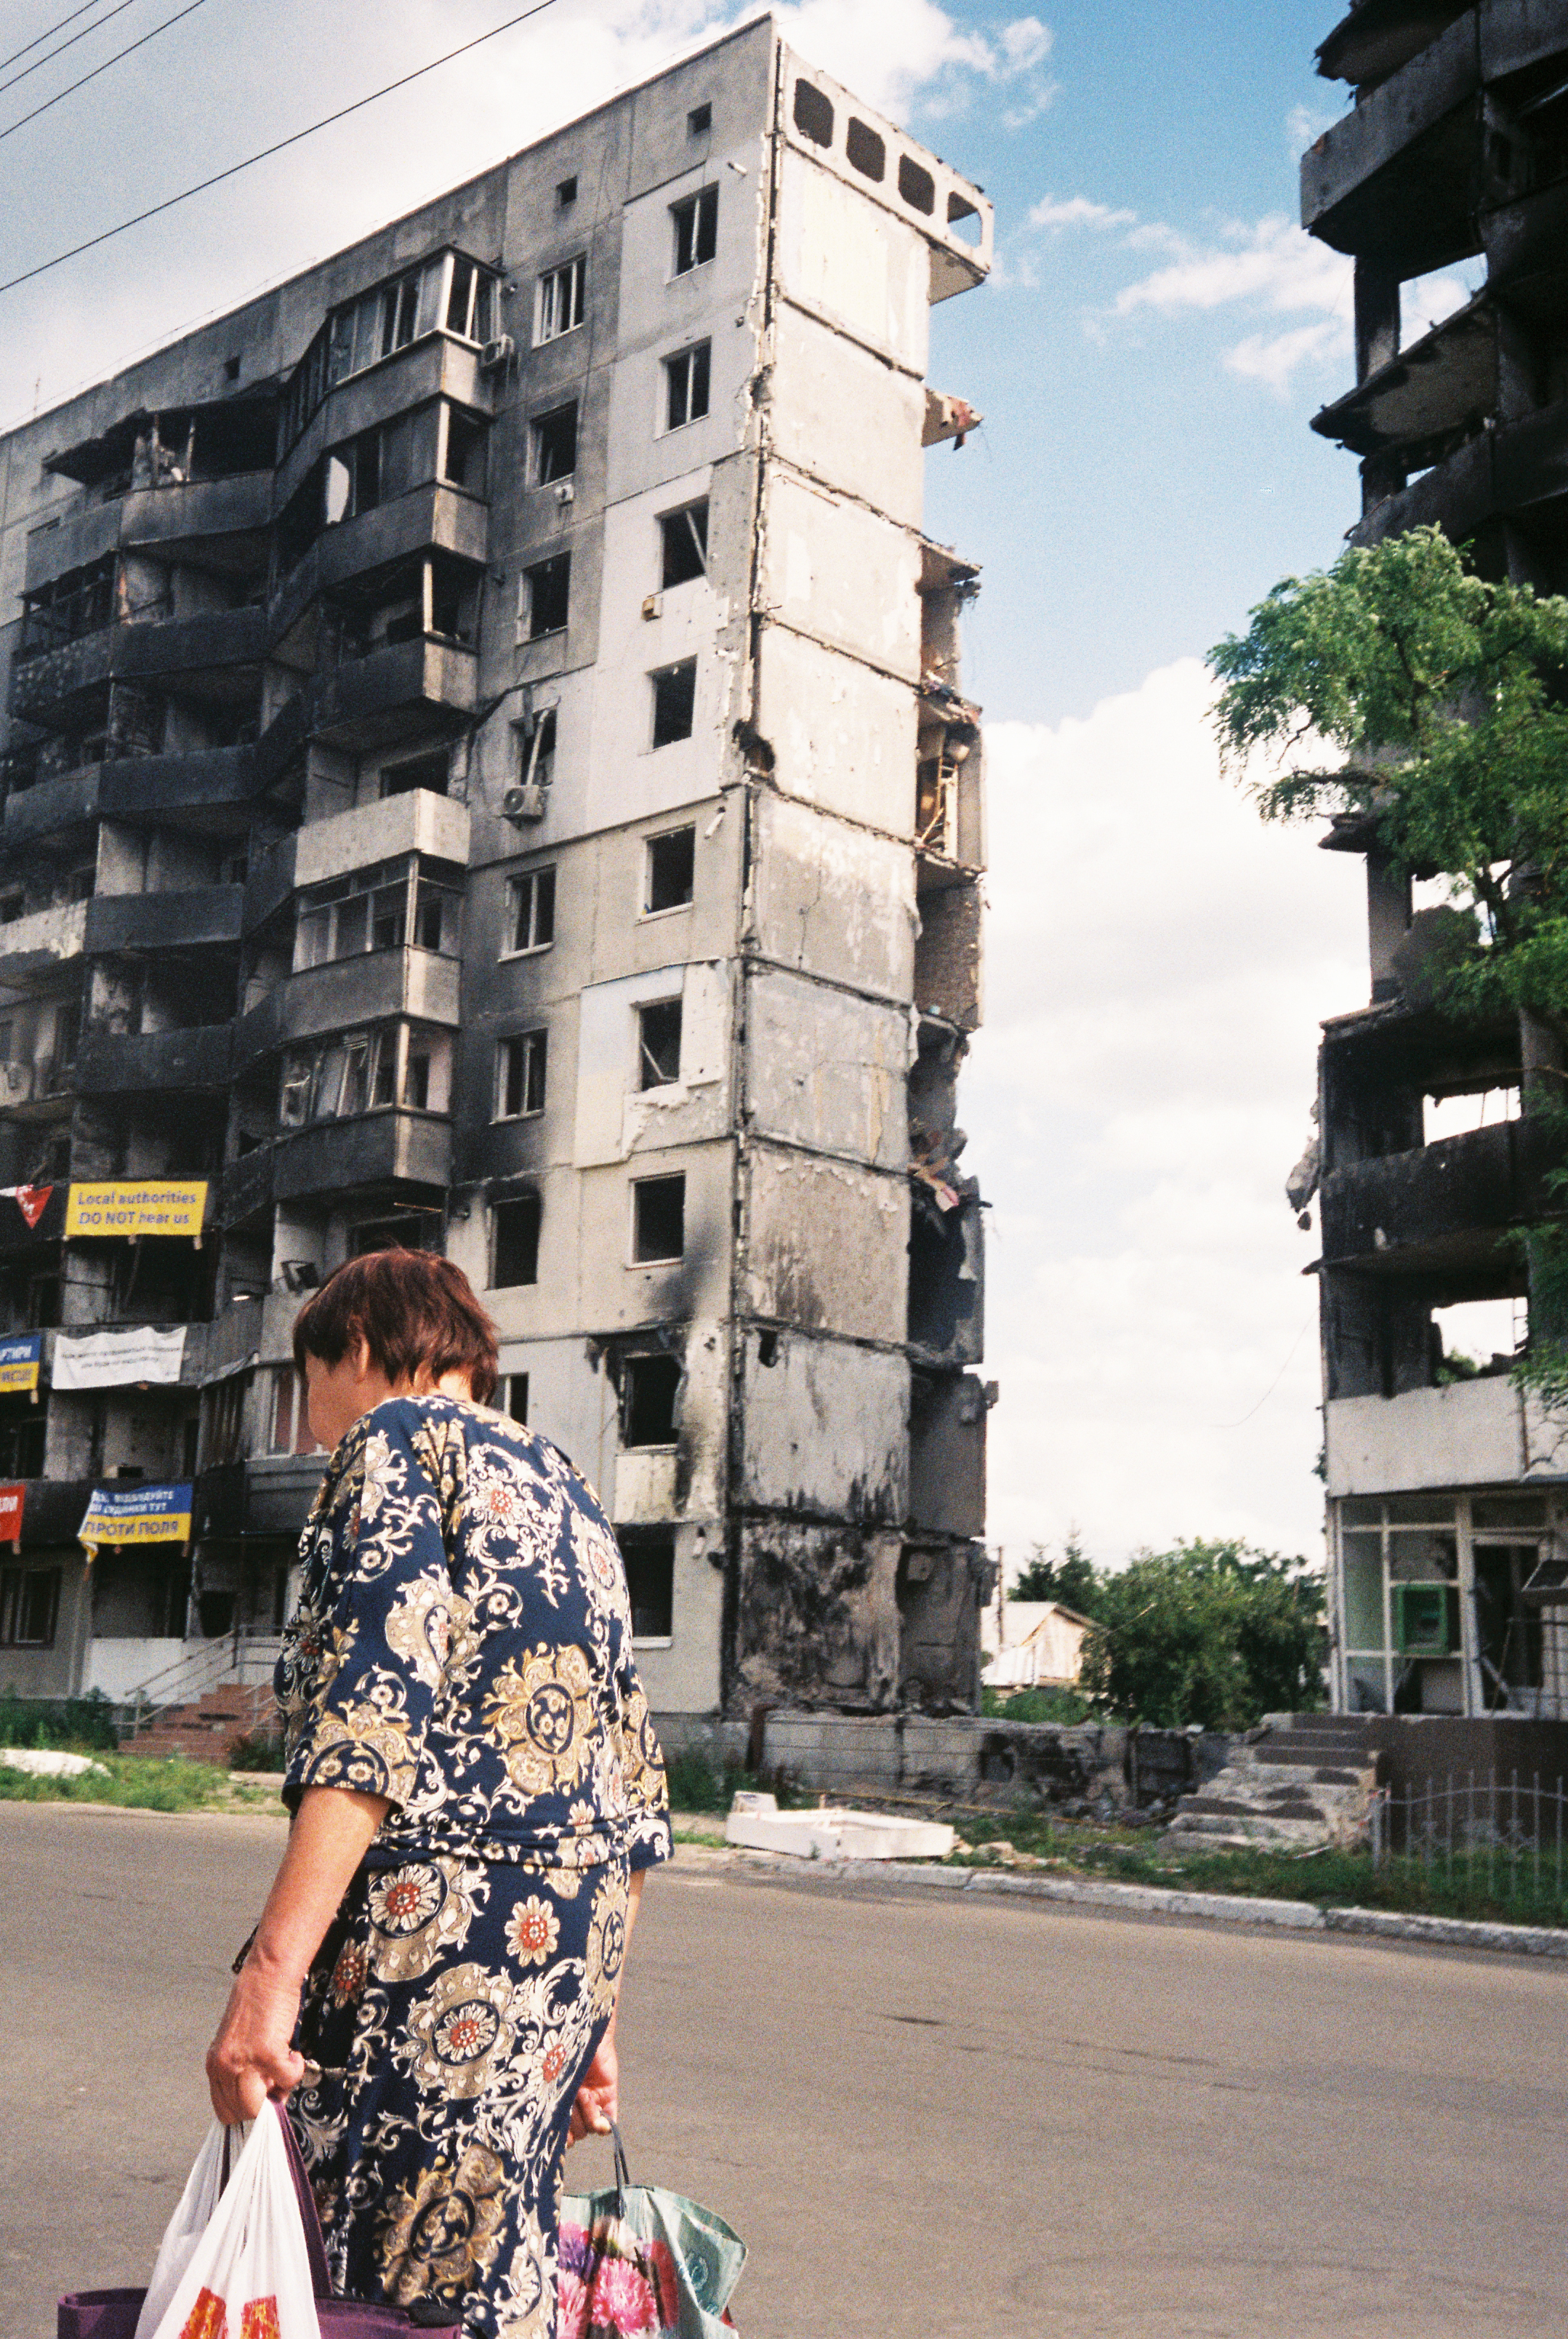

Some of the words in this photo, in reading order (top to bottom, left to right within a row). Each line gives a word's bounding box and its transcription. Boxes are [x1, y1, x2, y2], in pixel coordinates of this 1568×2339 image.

[77, 1191, 116, 1205] Local
[118, 1190, 196, 1205] authorities
[79, 1211, 102, 1224] DO
[105, 1211, 135, 1224] NOT
[138, 1211, 170, 1224] hear
[173, 1213, 190, 1224] us
[84, 1520, 136, 1536] ПРОТИ
[138, 1520, 179, 1536] ПОЛЯ
